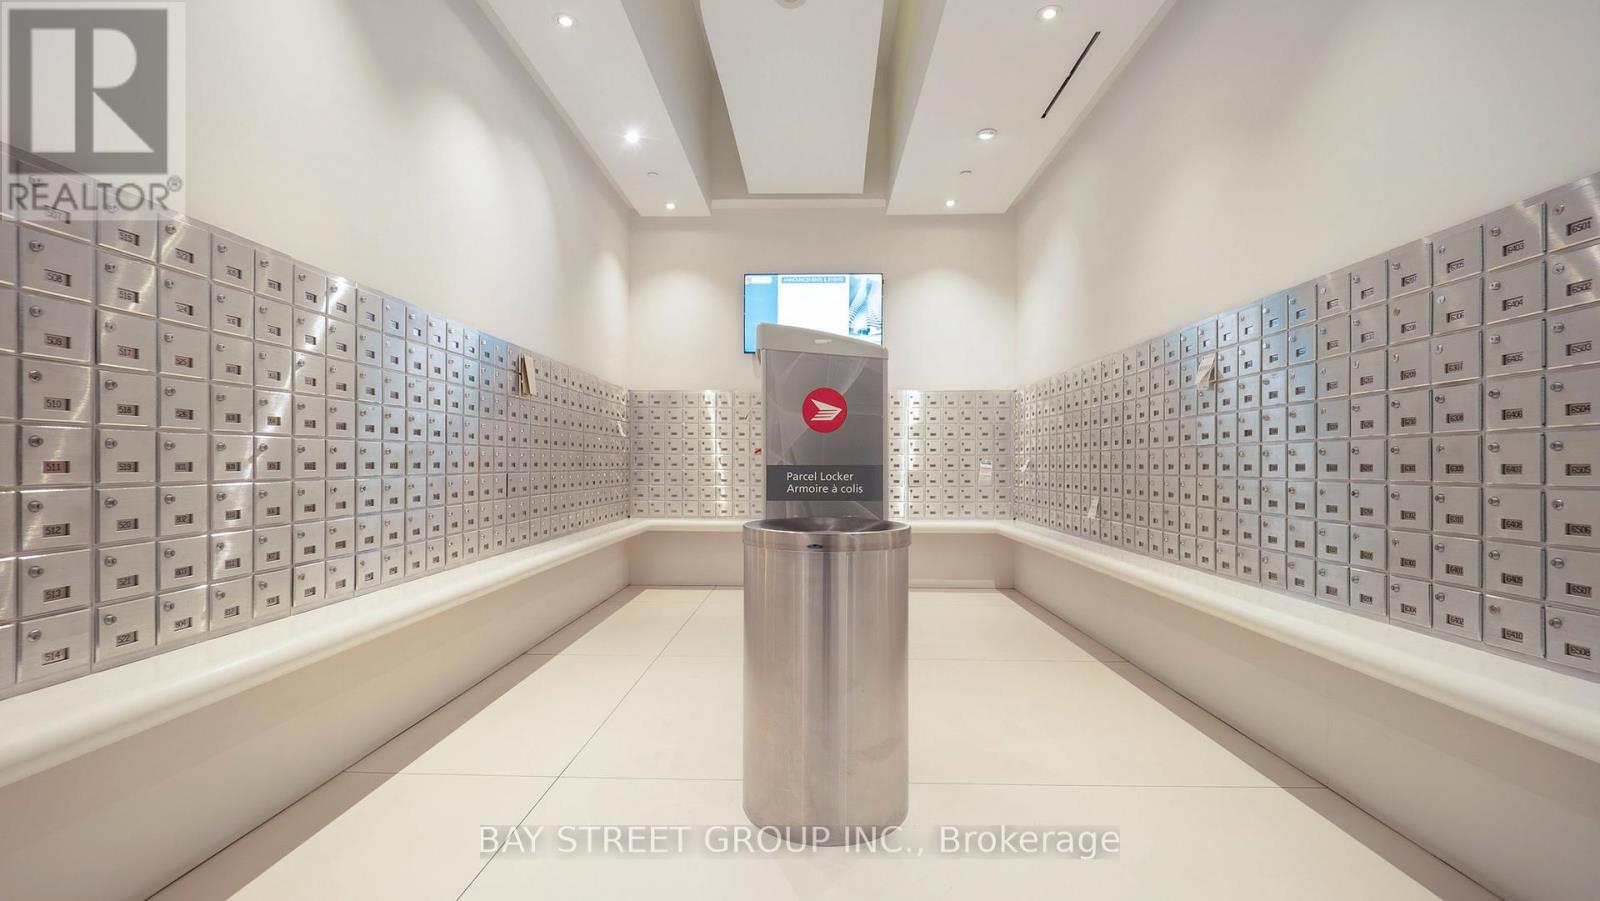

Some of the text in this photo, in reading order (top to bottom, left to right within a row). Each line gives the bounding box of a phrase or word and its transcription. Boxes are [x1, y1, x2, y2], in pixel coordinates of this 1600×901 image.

[1571, 221, 1591, 233] 6501
[1572, 343, 1591, 353] 6503
[45, 398, 62, 408] 510
[1571, 403, 1590, 413] 6504
[45, 462, 60, 471] 511
[787, 472, 854, 481] Parcel Locker
[787, 484, 864, 493] Armoire à colis
[117, 520, 131, 529] 520
[45, 525, 61, 535] 512
[45, 588, 61, 599] 513
[44, 650, 60, 661] 514
